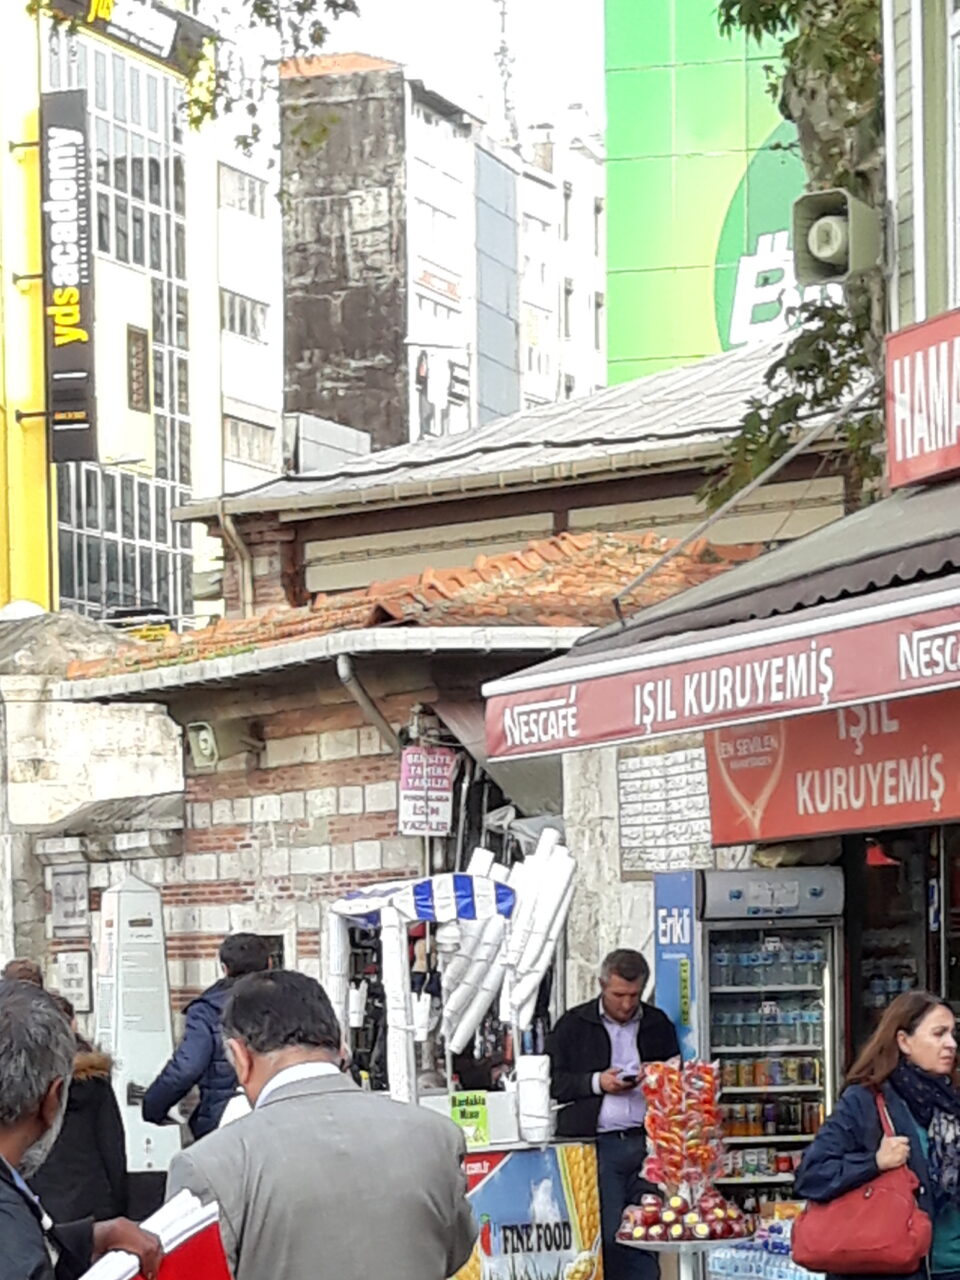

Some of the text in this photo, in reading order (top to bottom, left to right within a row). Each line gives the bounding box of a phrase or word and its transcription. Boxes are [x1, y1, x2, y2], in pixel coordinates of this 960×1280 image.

[633, 676, 677, 734] IŞIL
[683, 640, 835, 717] KURUYEMİŞ
[898, 621, 960, 681] NESC
[796, 744, 946, 815] KURUYEMİŞ
[502, 1221, 572, 1254] FINE FOOD
